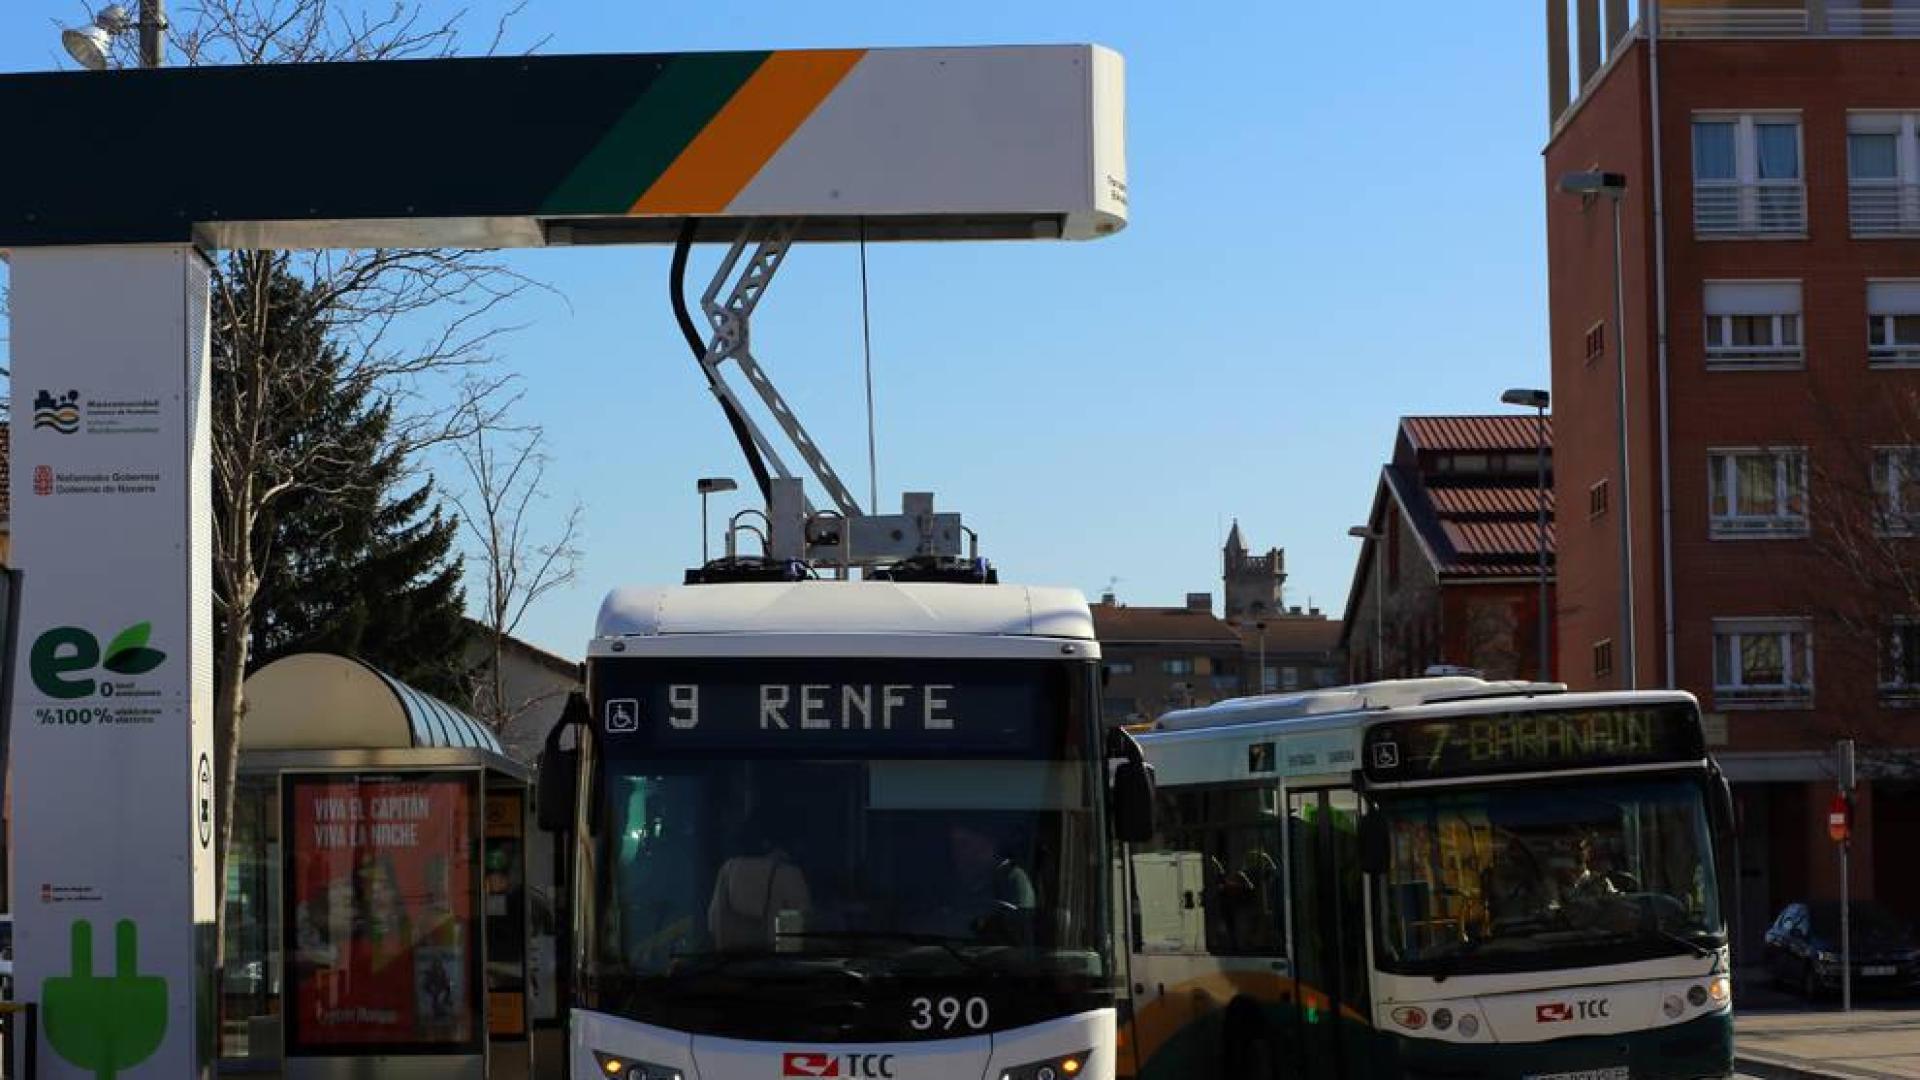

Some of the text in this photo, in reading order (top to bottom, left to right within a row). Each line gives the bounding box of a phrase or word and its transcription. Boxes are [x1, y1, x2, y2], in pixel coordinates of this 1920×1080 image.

[669, 684, 954, 729] 9 RENFE
[910, 997, 989, 1030] 390
[1577, 998, 1609, 1019] TCC
[847, 1054, 894, 1077] TCC
